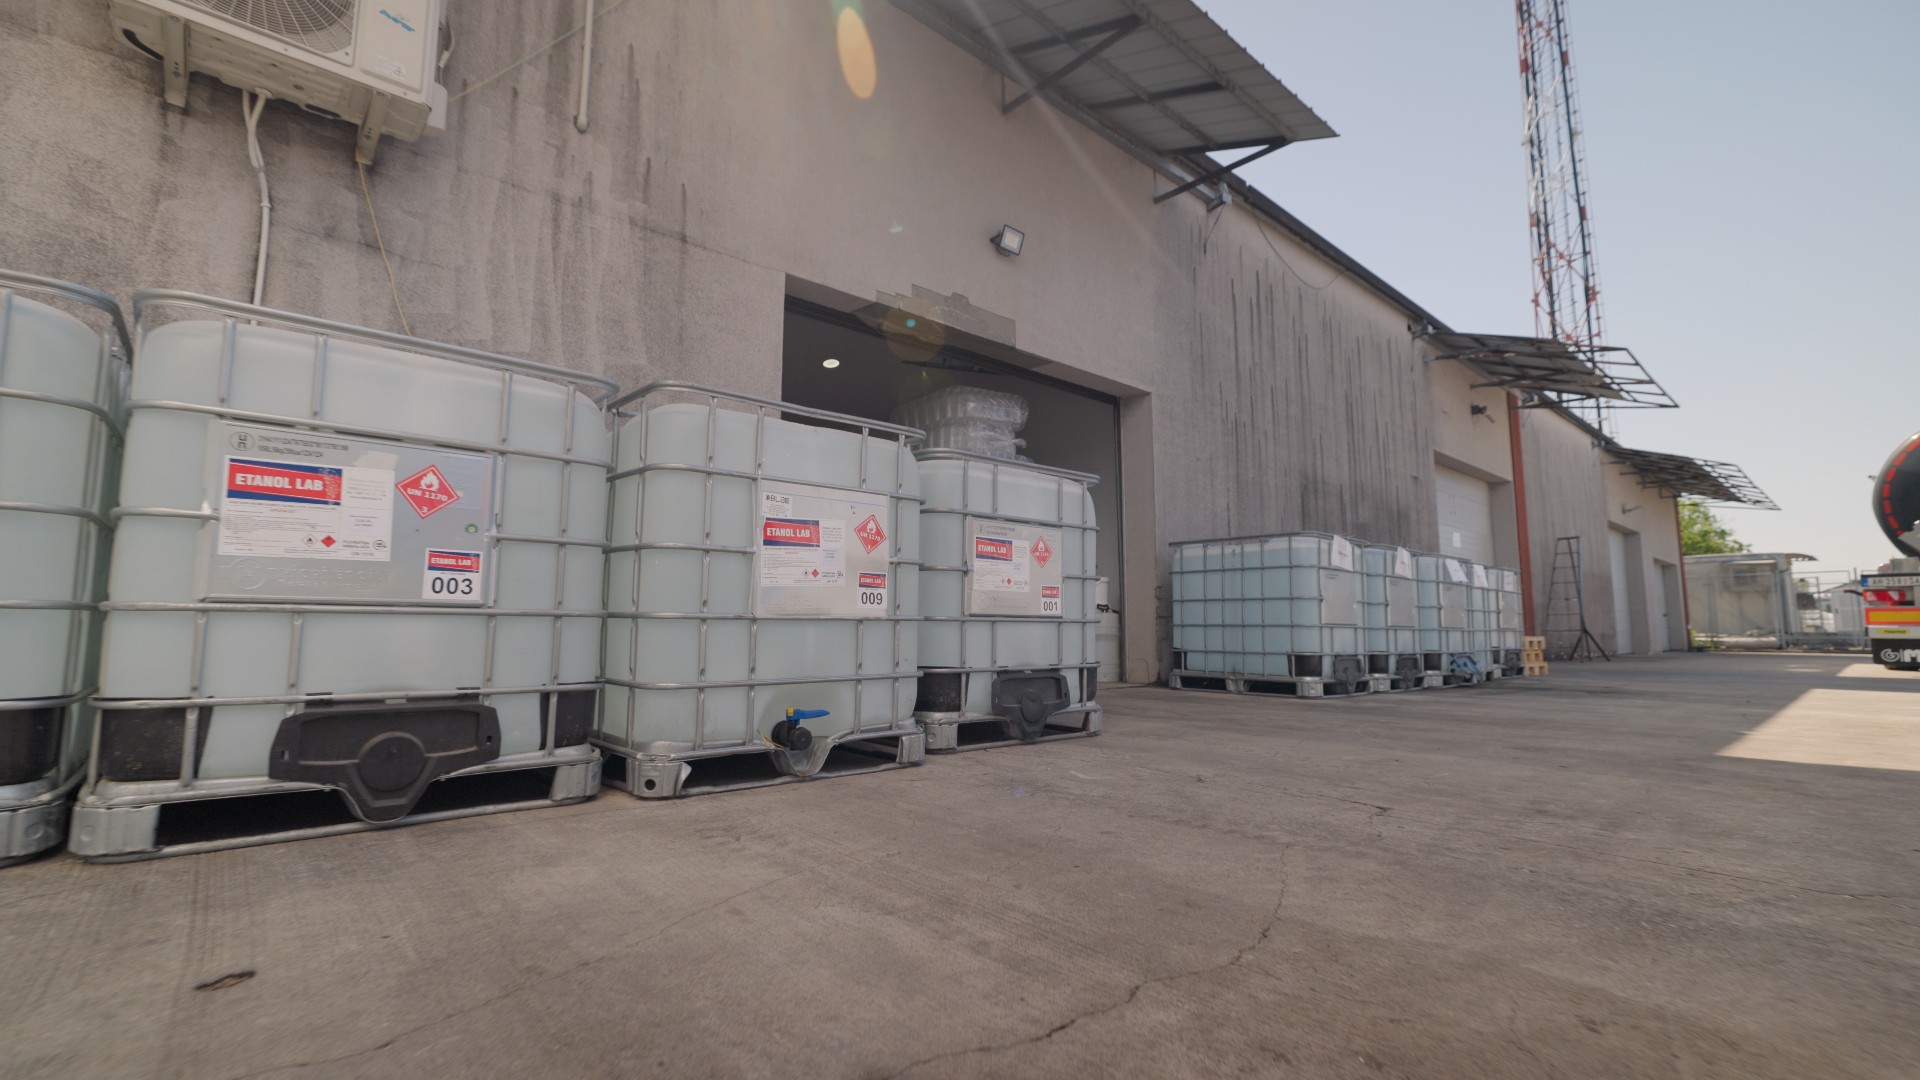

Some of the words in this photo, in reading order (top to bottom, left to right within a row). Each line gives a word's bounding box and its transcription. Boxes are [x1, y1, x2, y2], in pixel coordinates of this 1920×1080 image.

[235, 472, 292, 489] ETANOL
[295, 477, 324, 491] LAB
[407, 487, 422, 496] UN
[424, 491, 448, 501] 1170
[766, 527, 795, 537] ETANOL
[796, 528, 811, 538] LAB
[978, 544, 997, 553] ETANOL
[432, 576, 473, 595] 003
[861, 592, 883, 605] 009
[1043, 601, 1057, 611] 001
